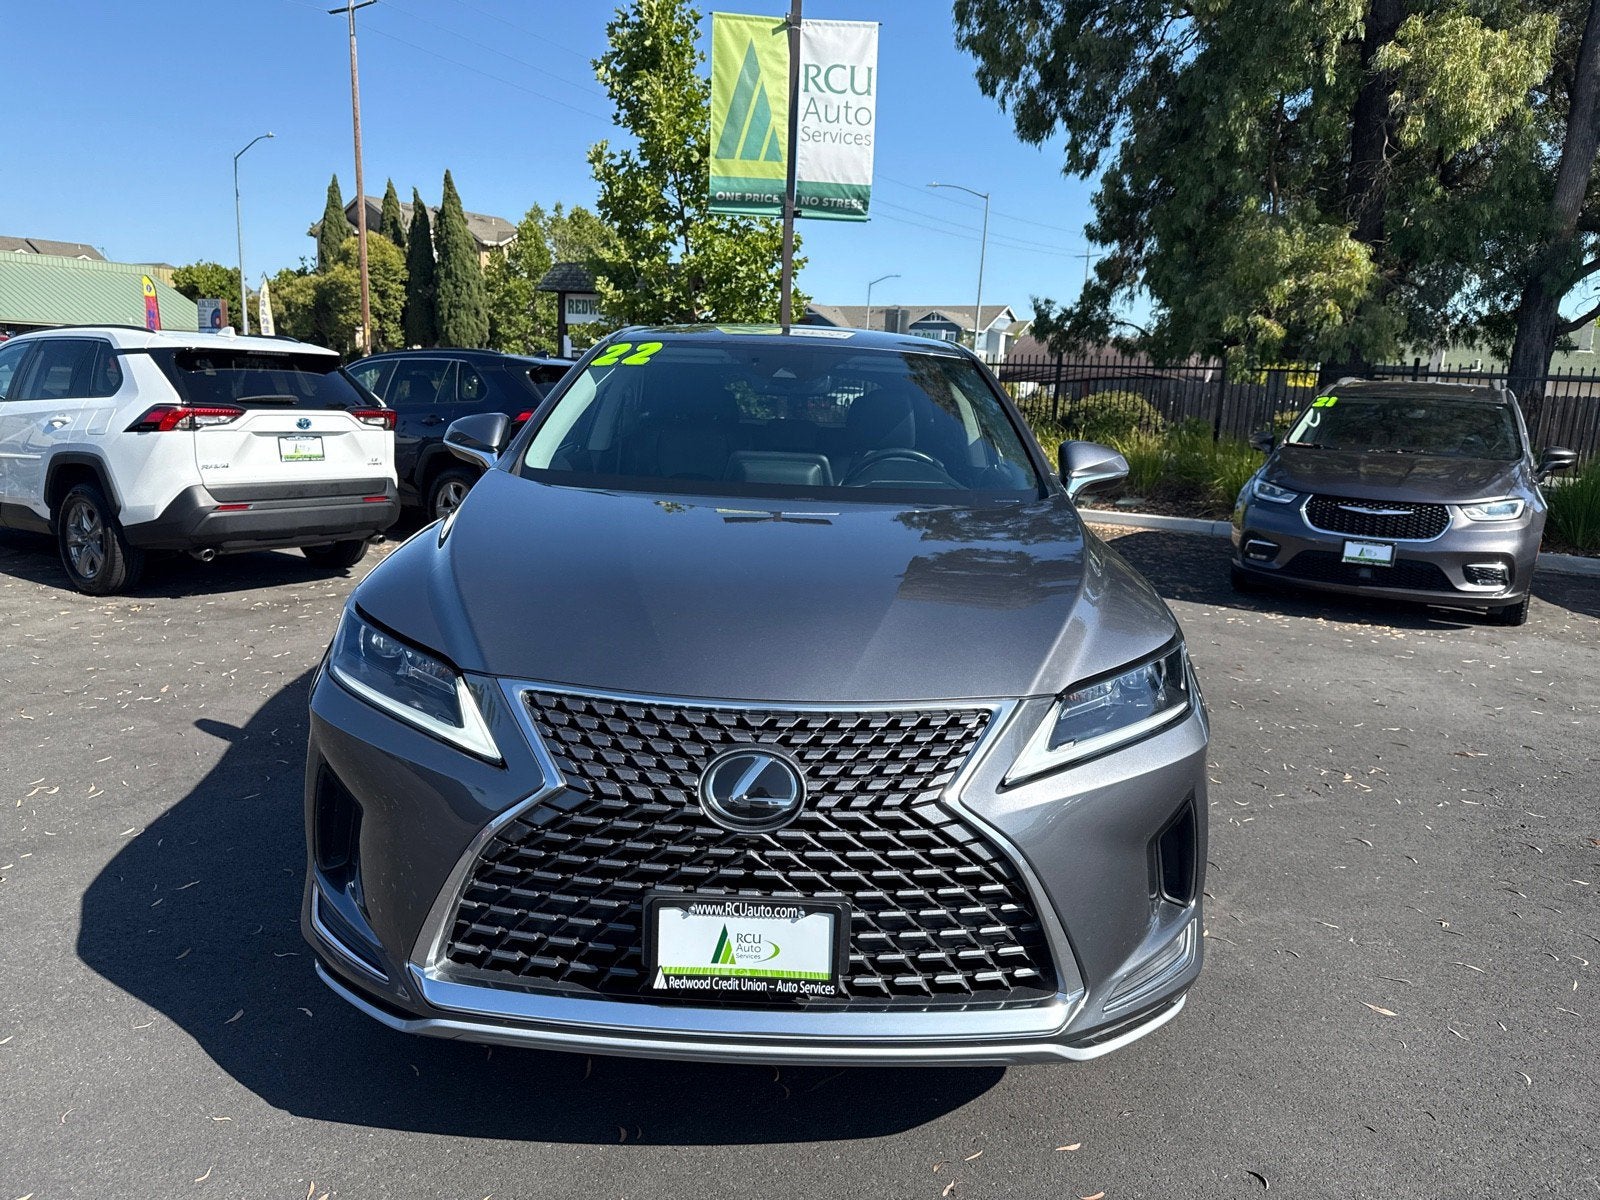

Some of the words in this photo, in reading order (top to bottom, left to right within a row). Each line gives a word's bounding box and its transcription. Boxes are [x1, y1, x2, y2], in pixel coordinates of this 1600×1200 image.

[802, 63, 873, 96] RCU
[801, 97, 872, 126] Auto
[801, 126, 872, 147] Services
[716, 191, 742, 201] ONE
[744, 192, 781, 204] PRICE
[801, 196, 820, 206] NO
[822, 197, 864, 210] STRESS
[567, 299, 602, 315] REDW
[590, 342, 663, 366] 22
[1312, 396, 1338, 407] 21
[695, 902, 798, 918] www.RCUauto.com
[736, 933, 762, 944] RCU
[736, 943, 762, 953] Auto
[668, 976, 710, 990] Redwood
[712, 977, 739, 991] Credit
[741, 978, 767, 991] Union
[776, 980, 798, 993] Auto
[799, 981, 835, 995] Services
